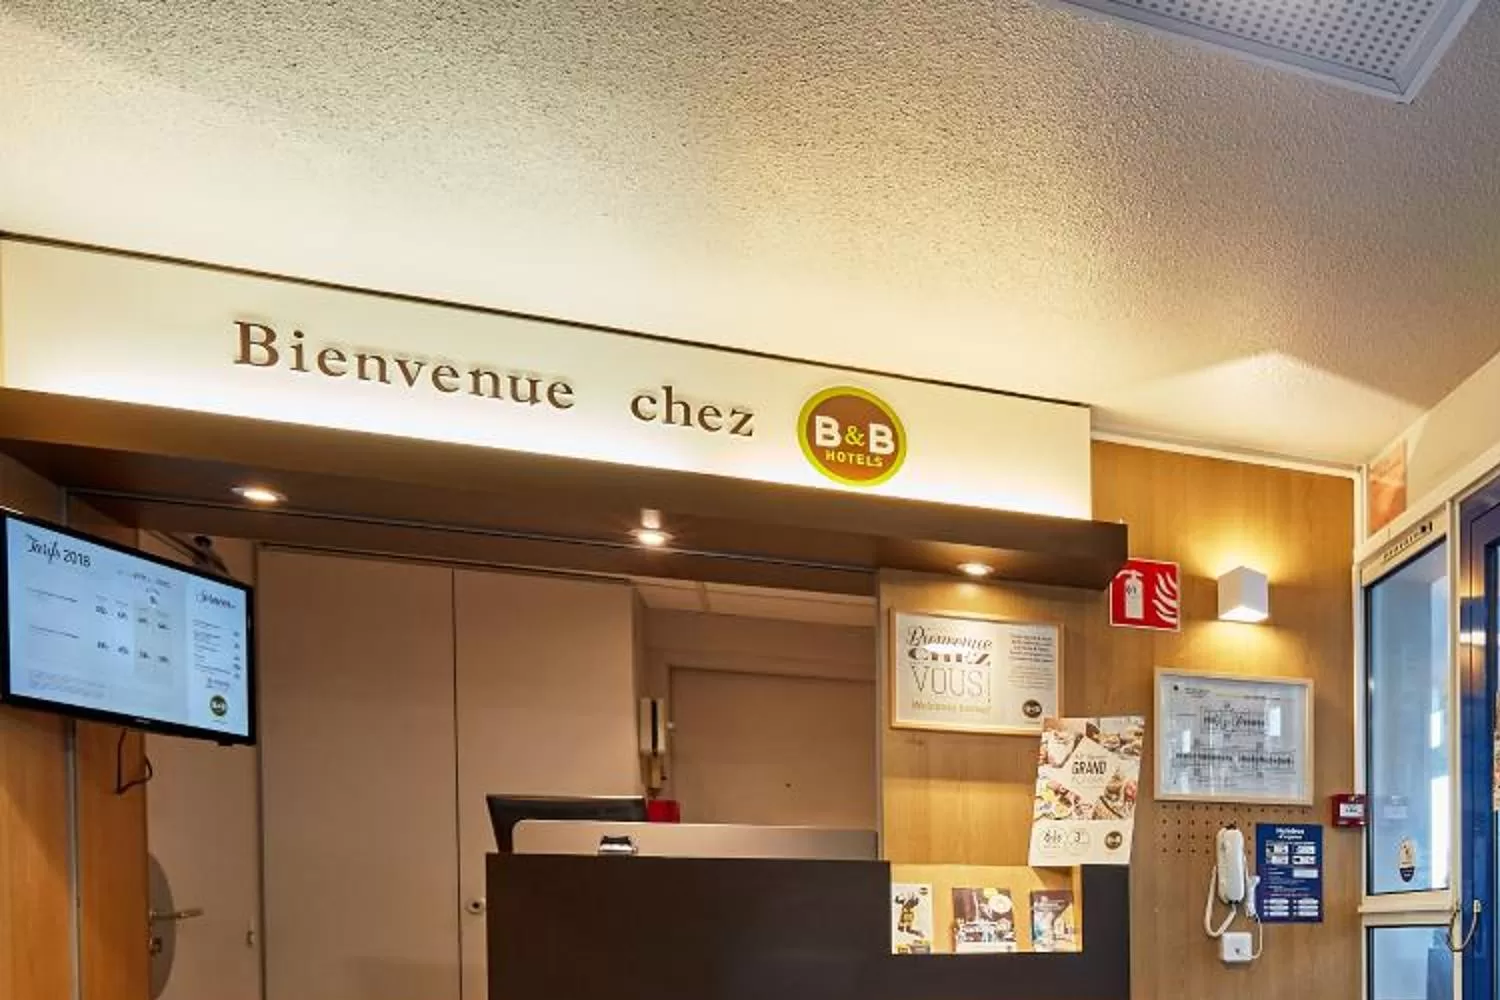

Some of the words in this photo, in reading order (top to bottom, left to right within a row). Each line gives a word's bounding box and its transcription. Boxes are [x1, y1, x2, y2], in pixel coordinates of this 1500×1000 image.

[233, 320, 574, 410] Bienvenue
[631, 385, 755, 437] chez
[825, 449, 883, 467] HOTELS
[25, 534, 61, 564] Tarifs
[63, 548, 91, 568] 2018
[1071, 761, 1107, 774] GRAND
